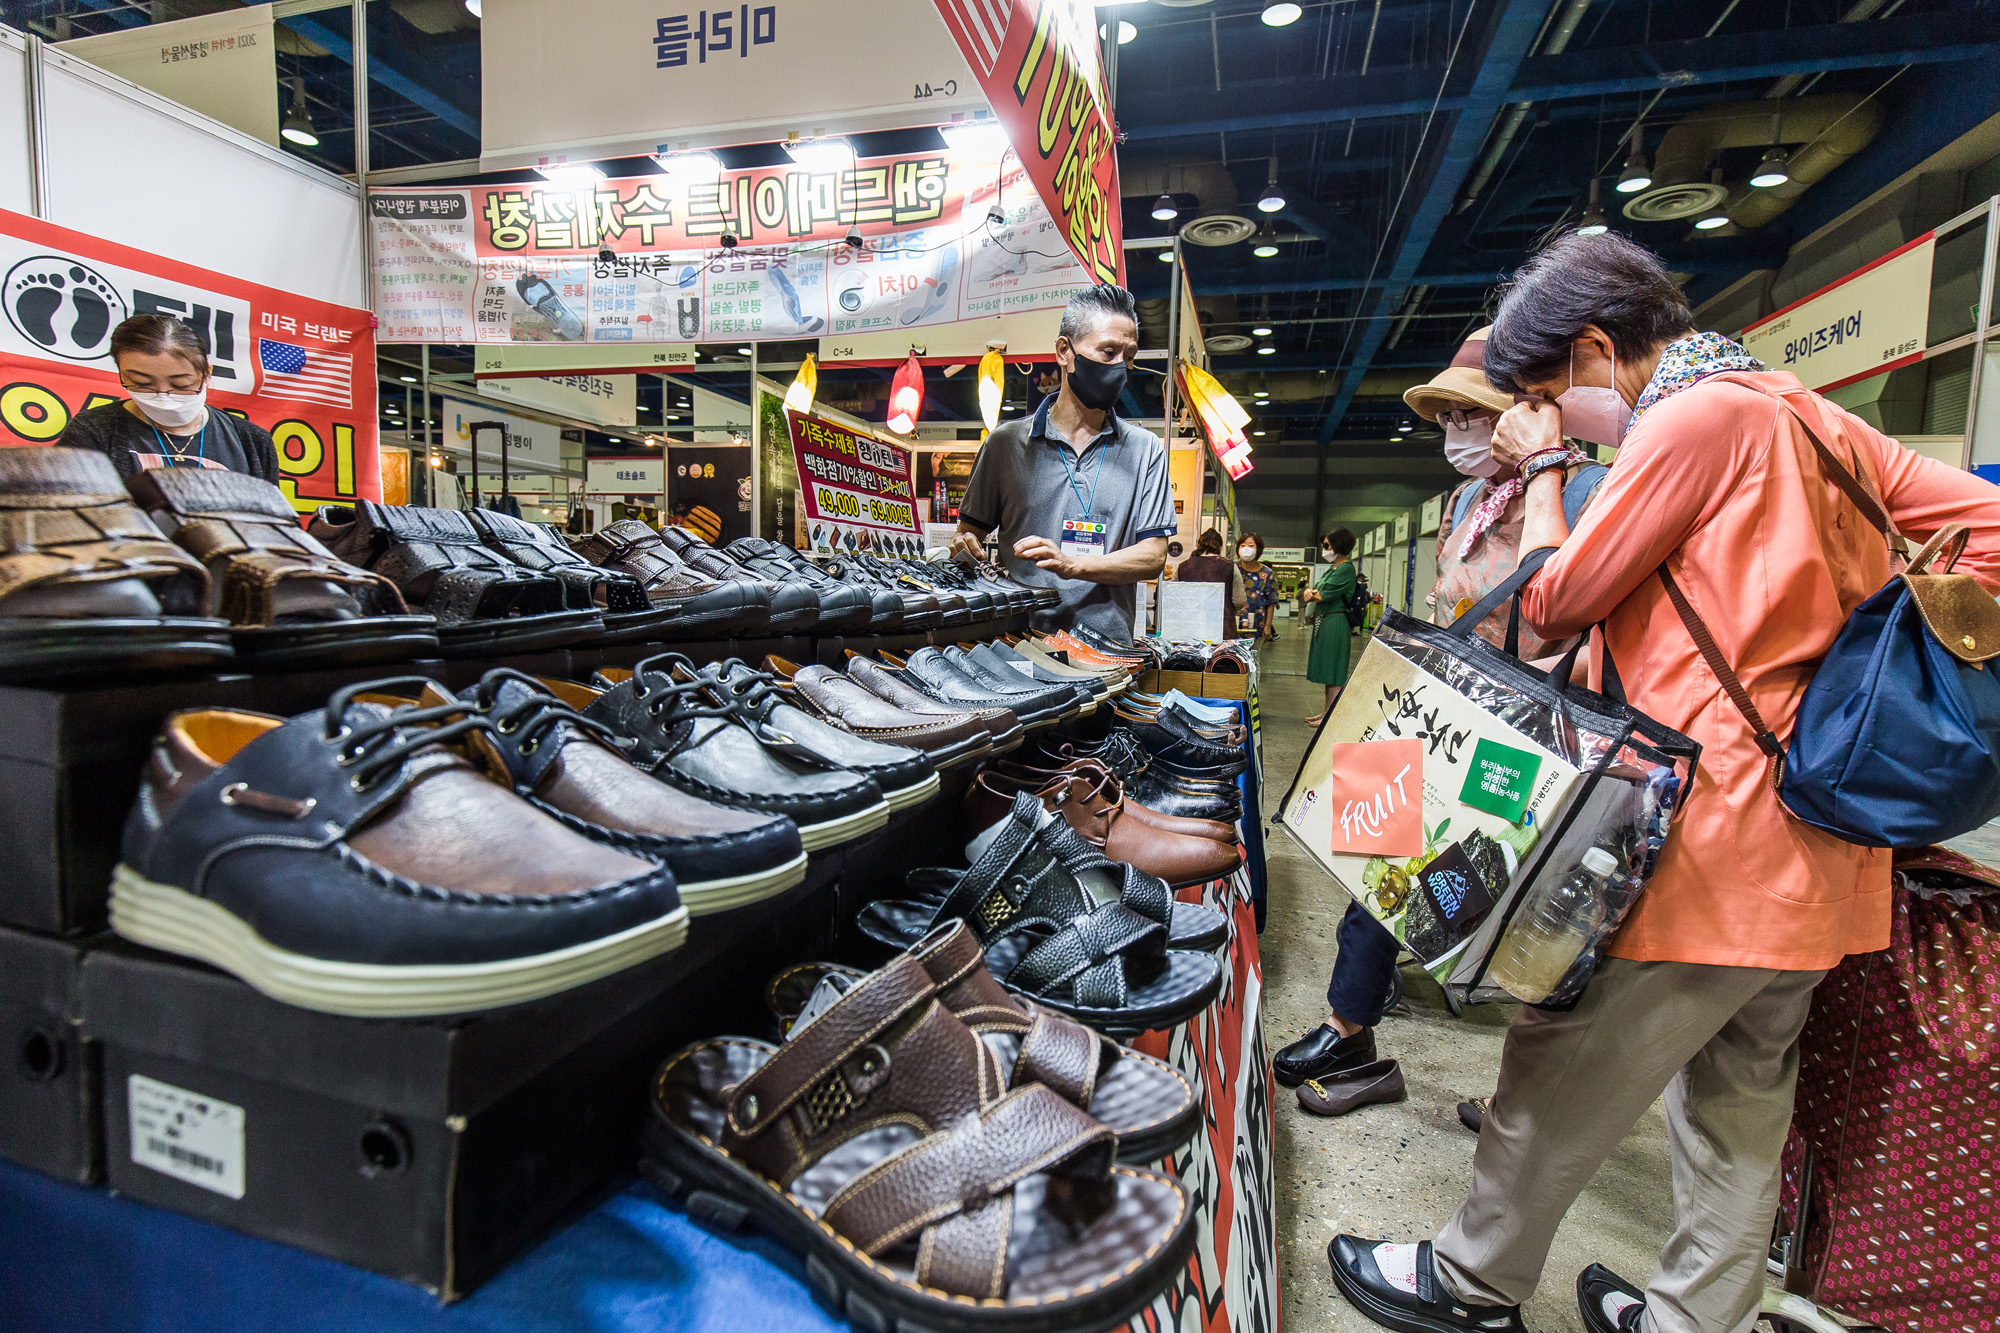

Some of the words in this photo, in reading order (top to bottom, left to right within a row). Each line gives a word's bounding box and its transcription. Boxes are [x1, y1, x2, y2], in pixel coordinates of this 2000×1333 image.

[261, 311, 298, 336] 미국
[302, 321, 353, 344] 브랜드
[1783, 310, 1862, 364] 와이즈케어
[485, 361, 502, 369] C-52
[653, 354, 666, 363] 전북
[668, 352, 688, 362] 진안군
[833, 348, 853, 356] C-54
[797, 418, 856, 458] 가죽수제화
[616, 471, 646, 481] 태초솔트
[803, 452, 878, 491] 백화점70%할인
[818, 487, 860, 518] 49,000
[869, 499, 914, 529] 69,000원
[1480, 759, 1521, 780] 원주농부의
[1483, 771, 1510, 787] 생생한
[1339, 763, 1411, 843] FRUIT
[1480, 780, 1520, 802] 명품농식품
[1529, 770, 1560, 812] (주)광천맛김
[1427, 872, 1455, 920] WONJU
[1433, 871, 1461, 912] GREEN
